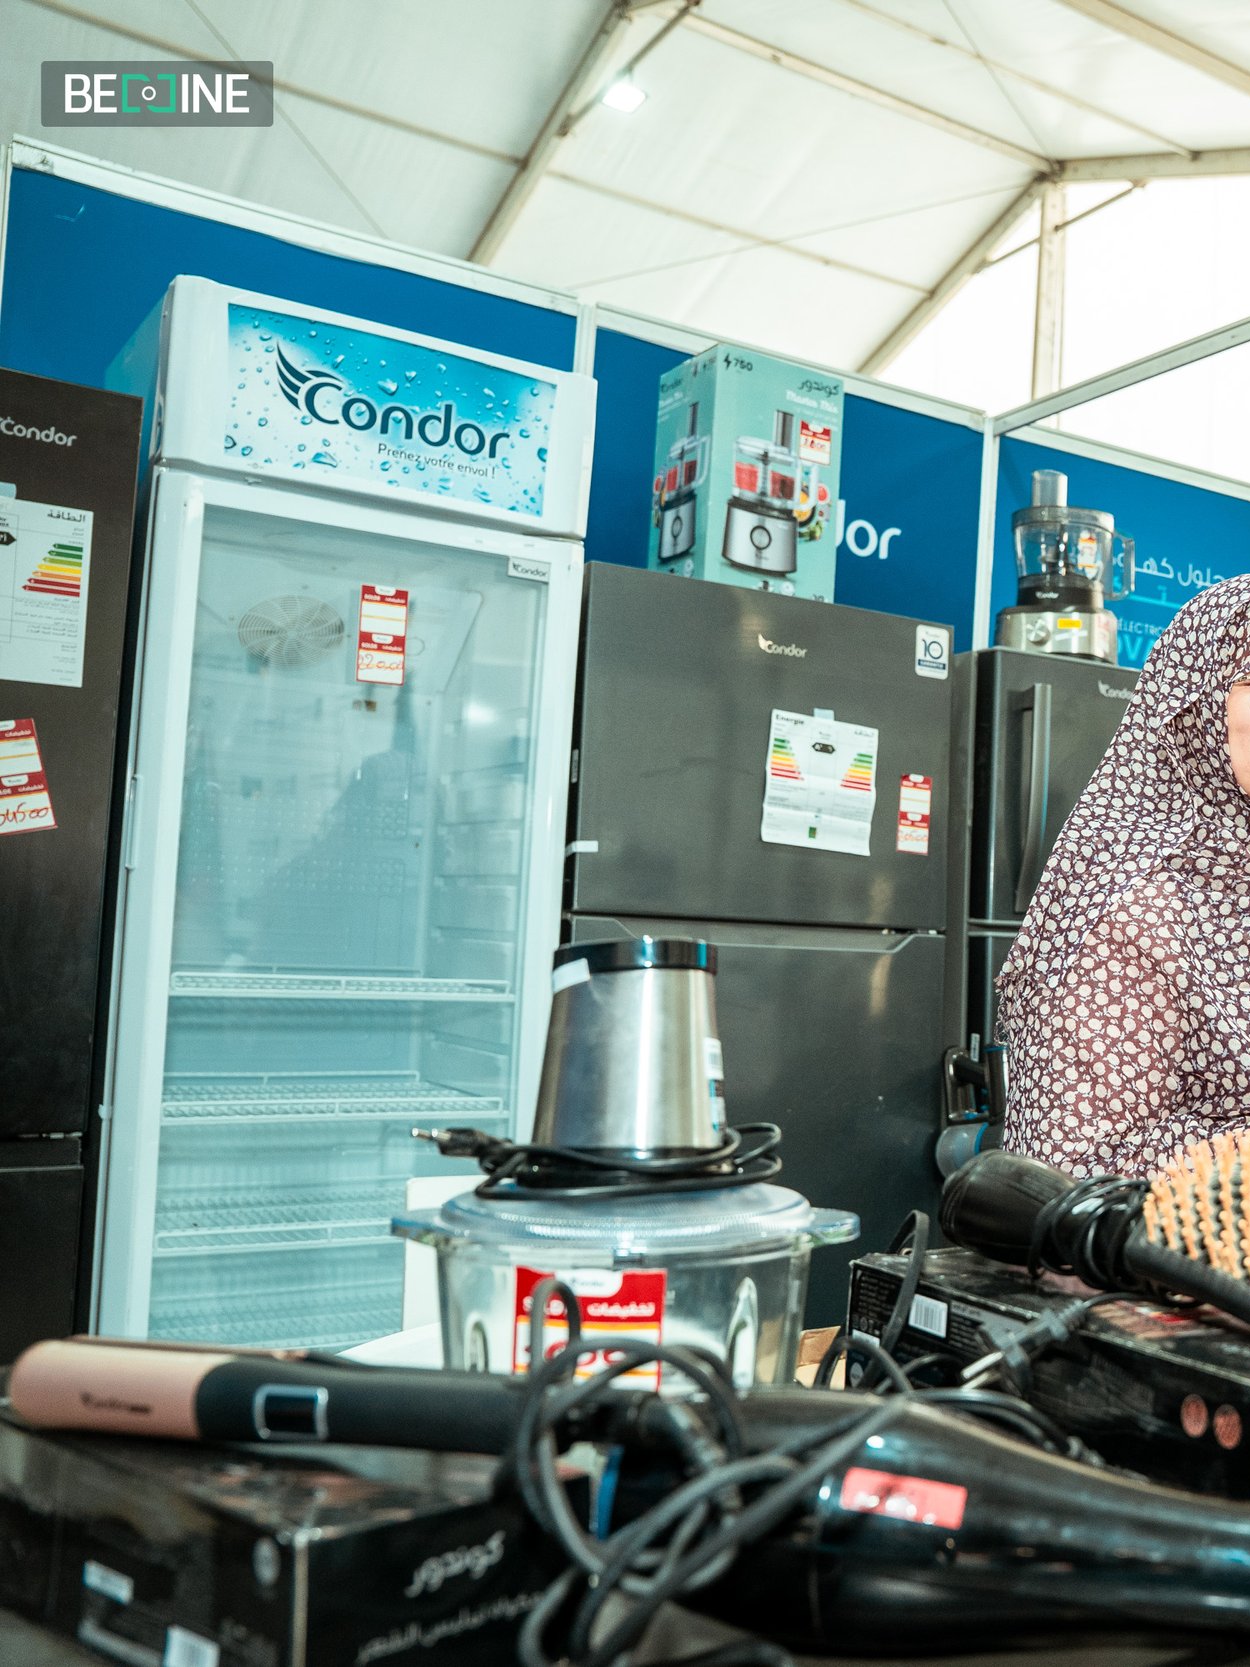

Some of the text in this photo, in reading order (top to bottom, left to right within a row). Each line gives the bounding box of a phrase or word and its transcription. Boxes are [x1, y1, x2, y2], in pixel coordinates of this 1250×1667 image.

[0, 418, 77, 447] Condor
[304, 379, 510, 458] Condor
[378, 443, 421, 463] Prenez
[424, 456, 455, 471] votre
[457, 463, 488, 478] envol
[47, 509, 86, 523] الطاقة
[766, 639, 808, 658] Condor
[586, 1301, 656, 1319] تخفيضات
[403, 1529, 507, 1598] كوندور
